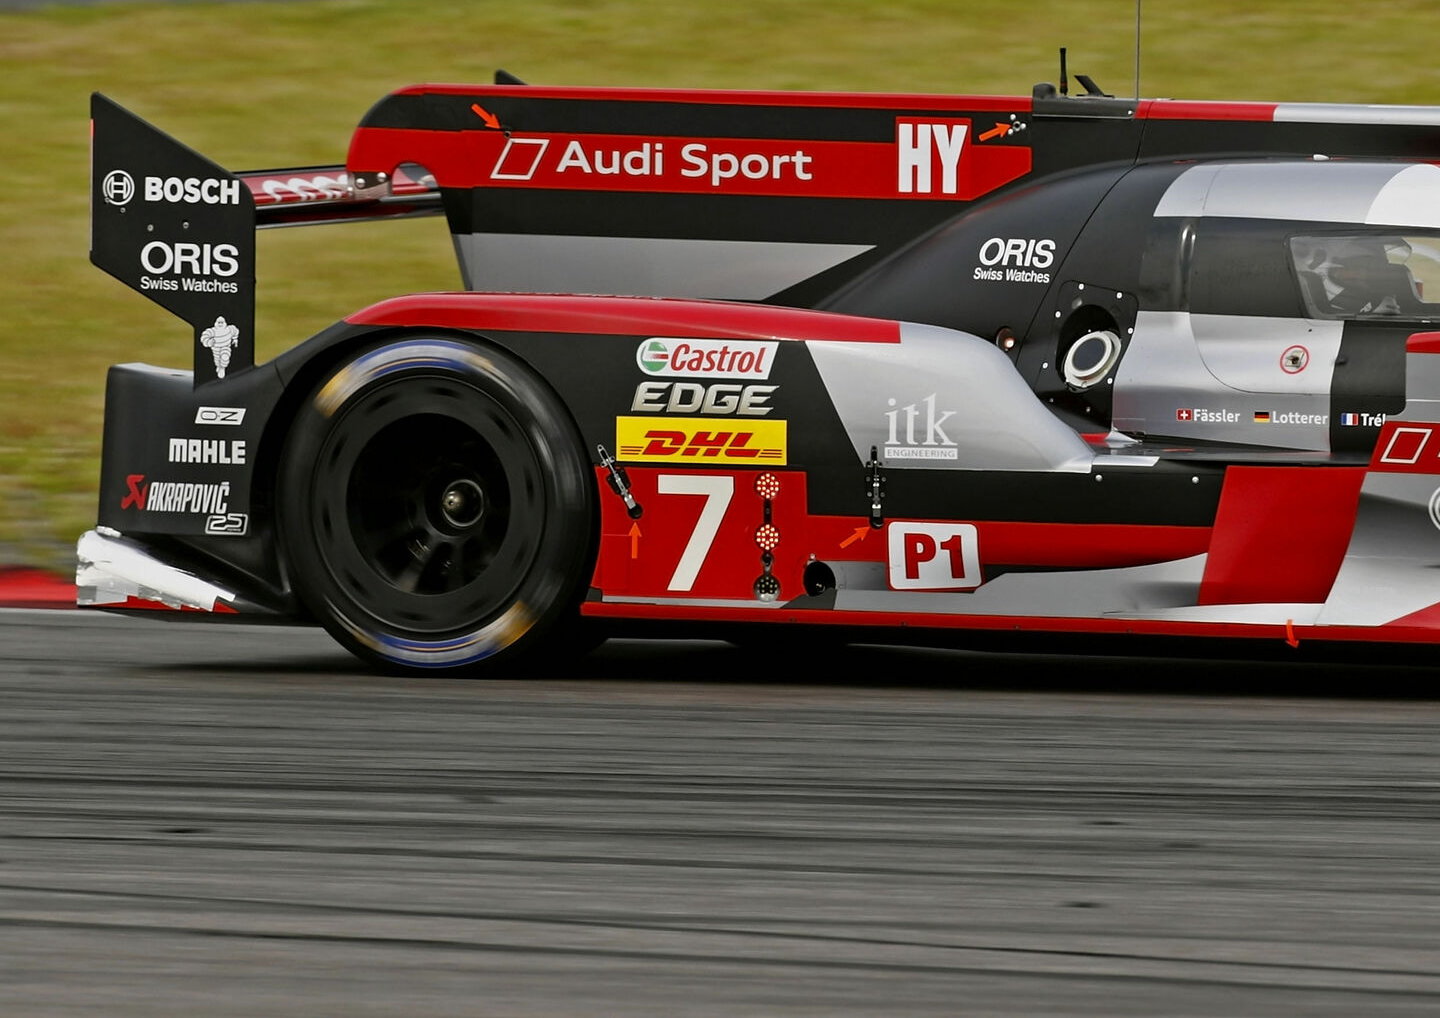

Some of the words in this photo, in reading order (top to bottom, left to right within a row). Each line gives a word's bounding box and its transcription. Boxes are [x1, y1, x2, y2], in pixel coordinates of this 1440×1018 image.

[556, 140, 663, 176] Audi
[680, 142, 813, 186] Sport
[898, 123, 969, 194] HY
[144, 176, 240, 205] BOSCH
[140, 240, 240, 277] ORIS
[979, 237, 1057, 269] ORIS
[140, 276, 179, 290] Swiss
[182, 278, 238, 294] Watches
[973, 267, 1004, 281] Swiss
[1005, 268, 1051, 283] Watches
[670, 343, 767, 374] Castrol
[630, 381, 781, 416] EDGE
[884, 392, 959, 446] itk
[1194, 408, 1241, 423] Fässler
[1272, 411, 1328, 425] Lotterer
[168, 437, 247, 464] MAHLE
[642, 430, 754, 458] DHL
[886, 448, 957, 458] ENGINEERING
[657, 474, 735, 592] 7
[903, 532, 967, 580] P1
